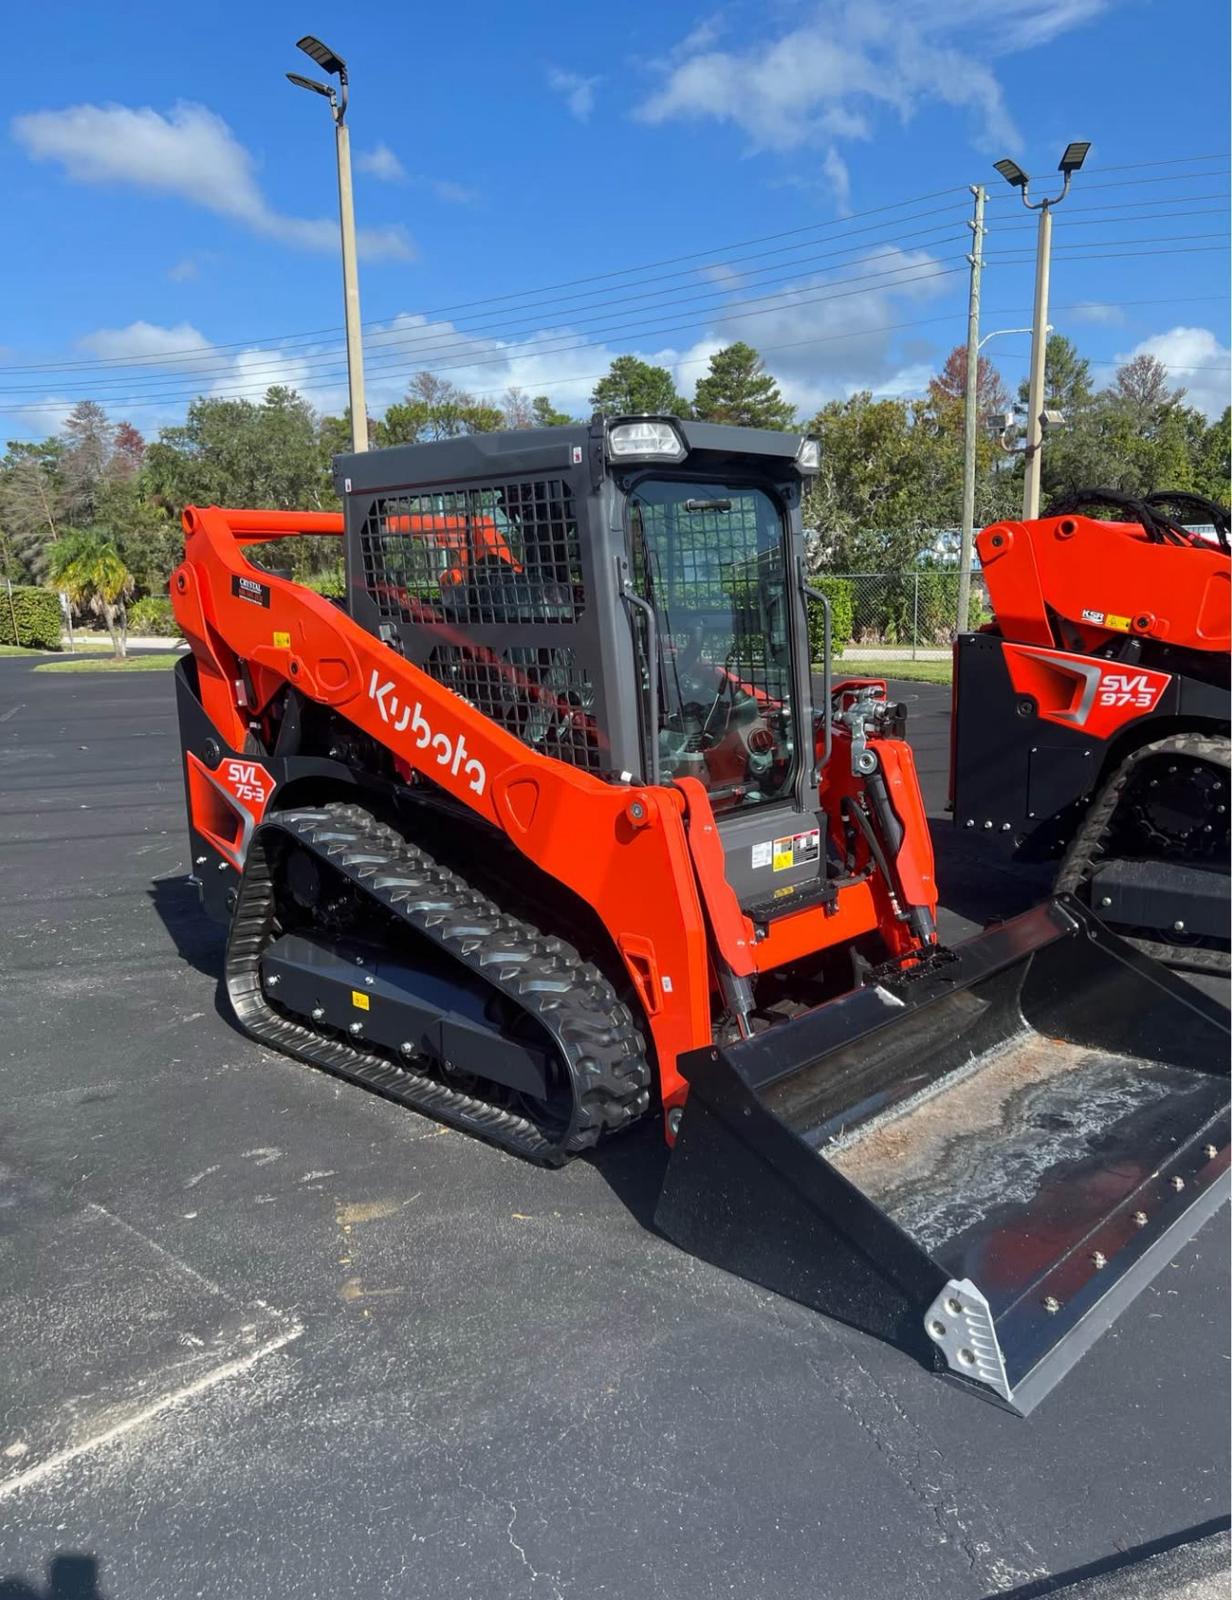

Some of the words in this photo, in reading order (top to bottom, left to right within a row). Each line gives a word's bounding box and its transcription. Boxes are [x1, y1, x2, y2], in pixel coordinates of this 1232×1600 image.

[1098, 675, 1157, 693] SVL
[1100, 693, 1152, 707] 97-3
[369, 669, 486, 796] Kubota
[228, 763, 262, 786] SVL
[235, 783, 264, 802] 75-3
